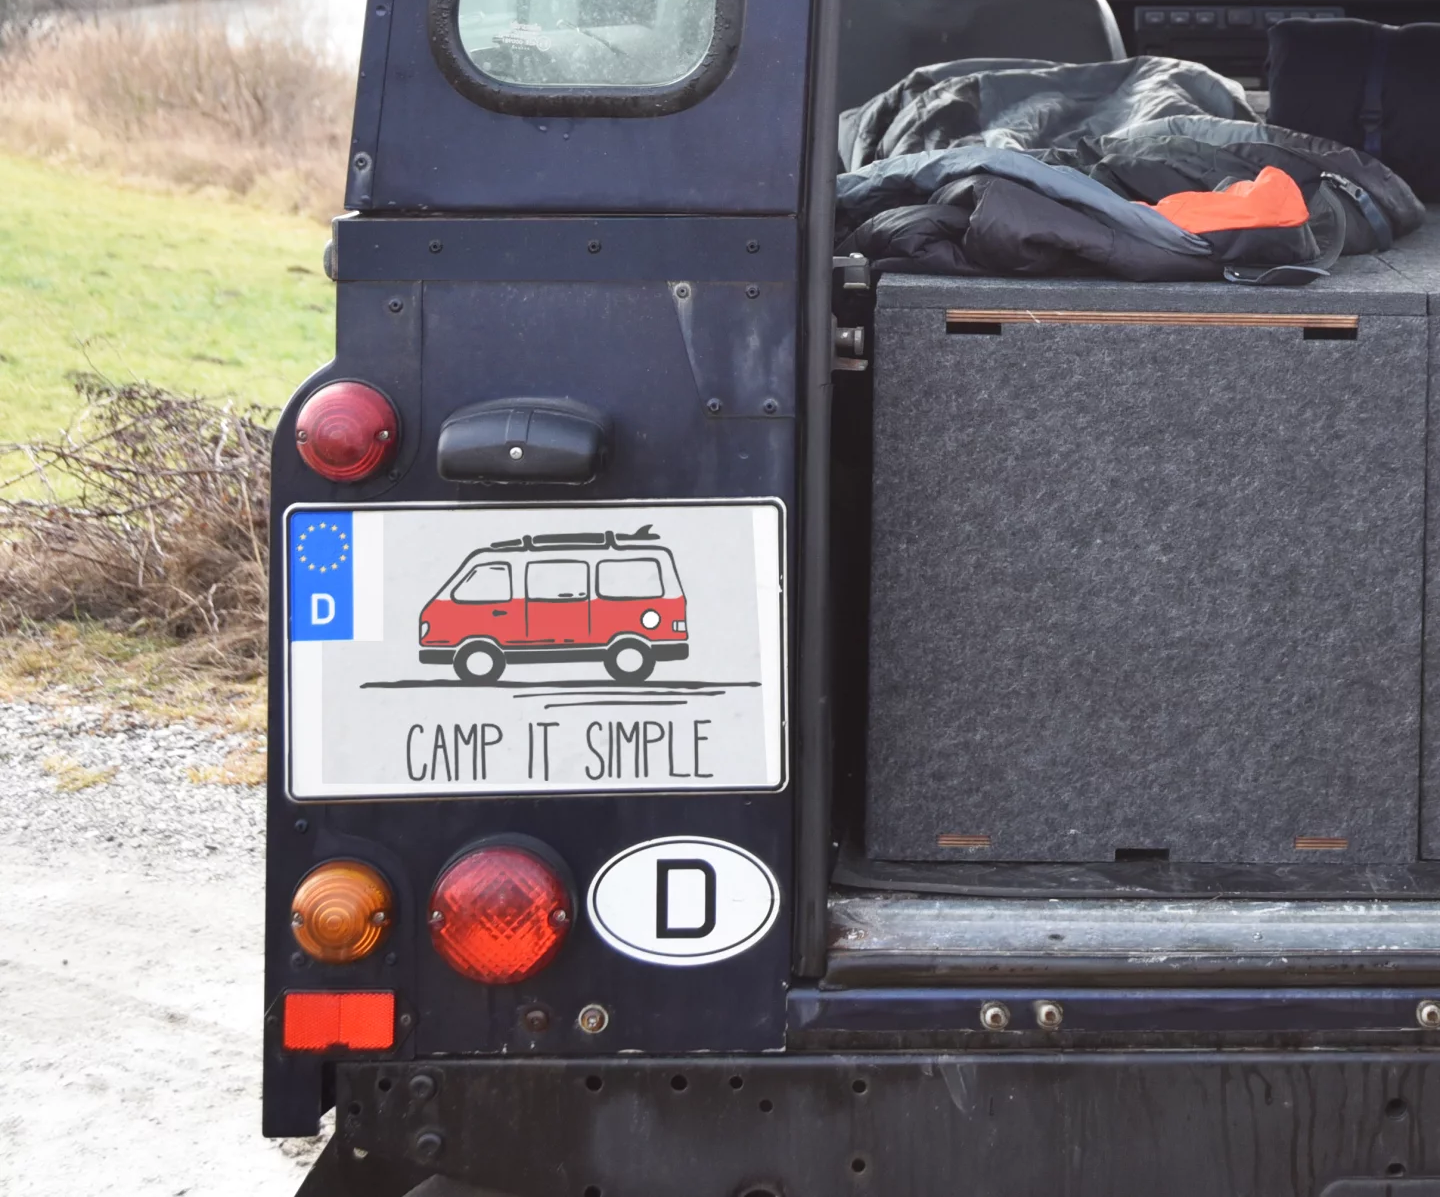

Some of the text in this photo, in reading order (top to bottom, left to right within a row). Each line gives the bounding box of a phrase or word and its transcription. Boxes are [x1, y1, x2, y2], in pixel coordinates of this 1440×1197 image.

[310, 592, 336, 626] D
[405, 718, 715, 782] CAMP IT SIMPLE
[656, 858, 718, 939] D
